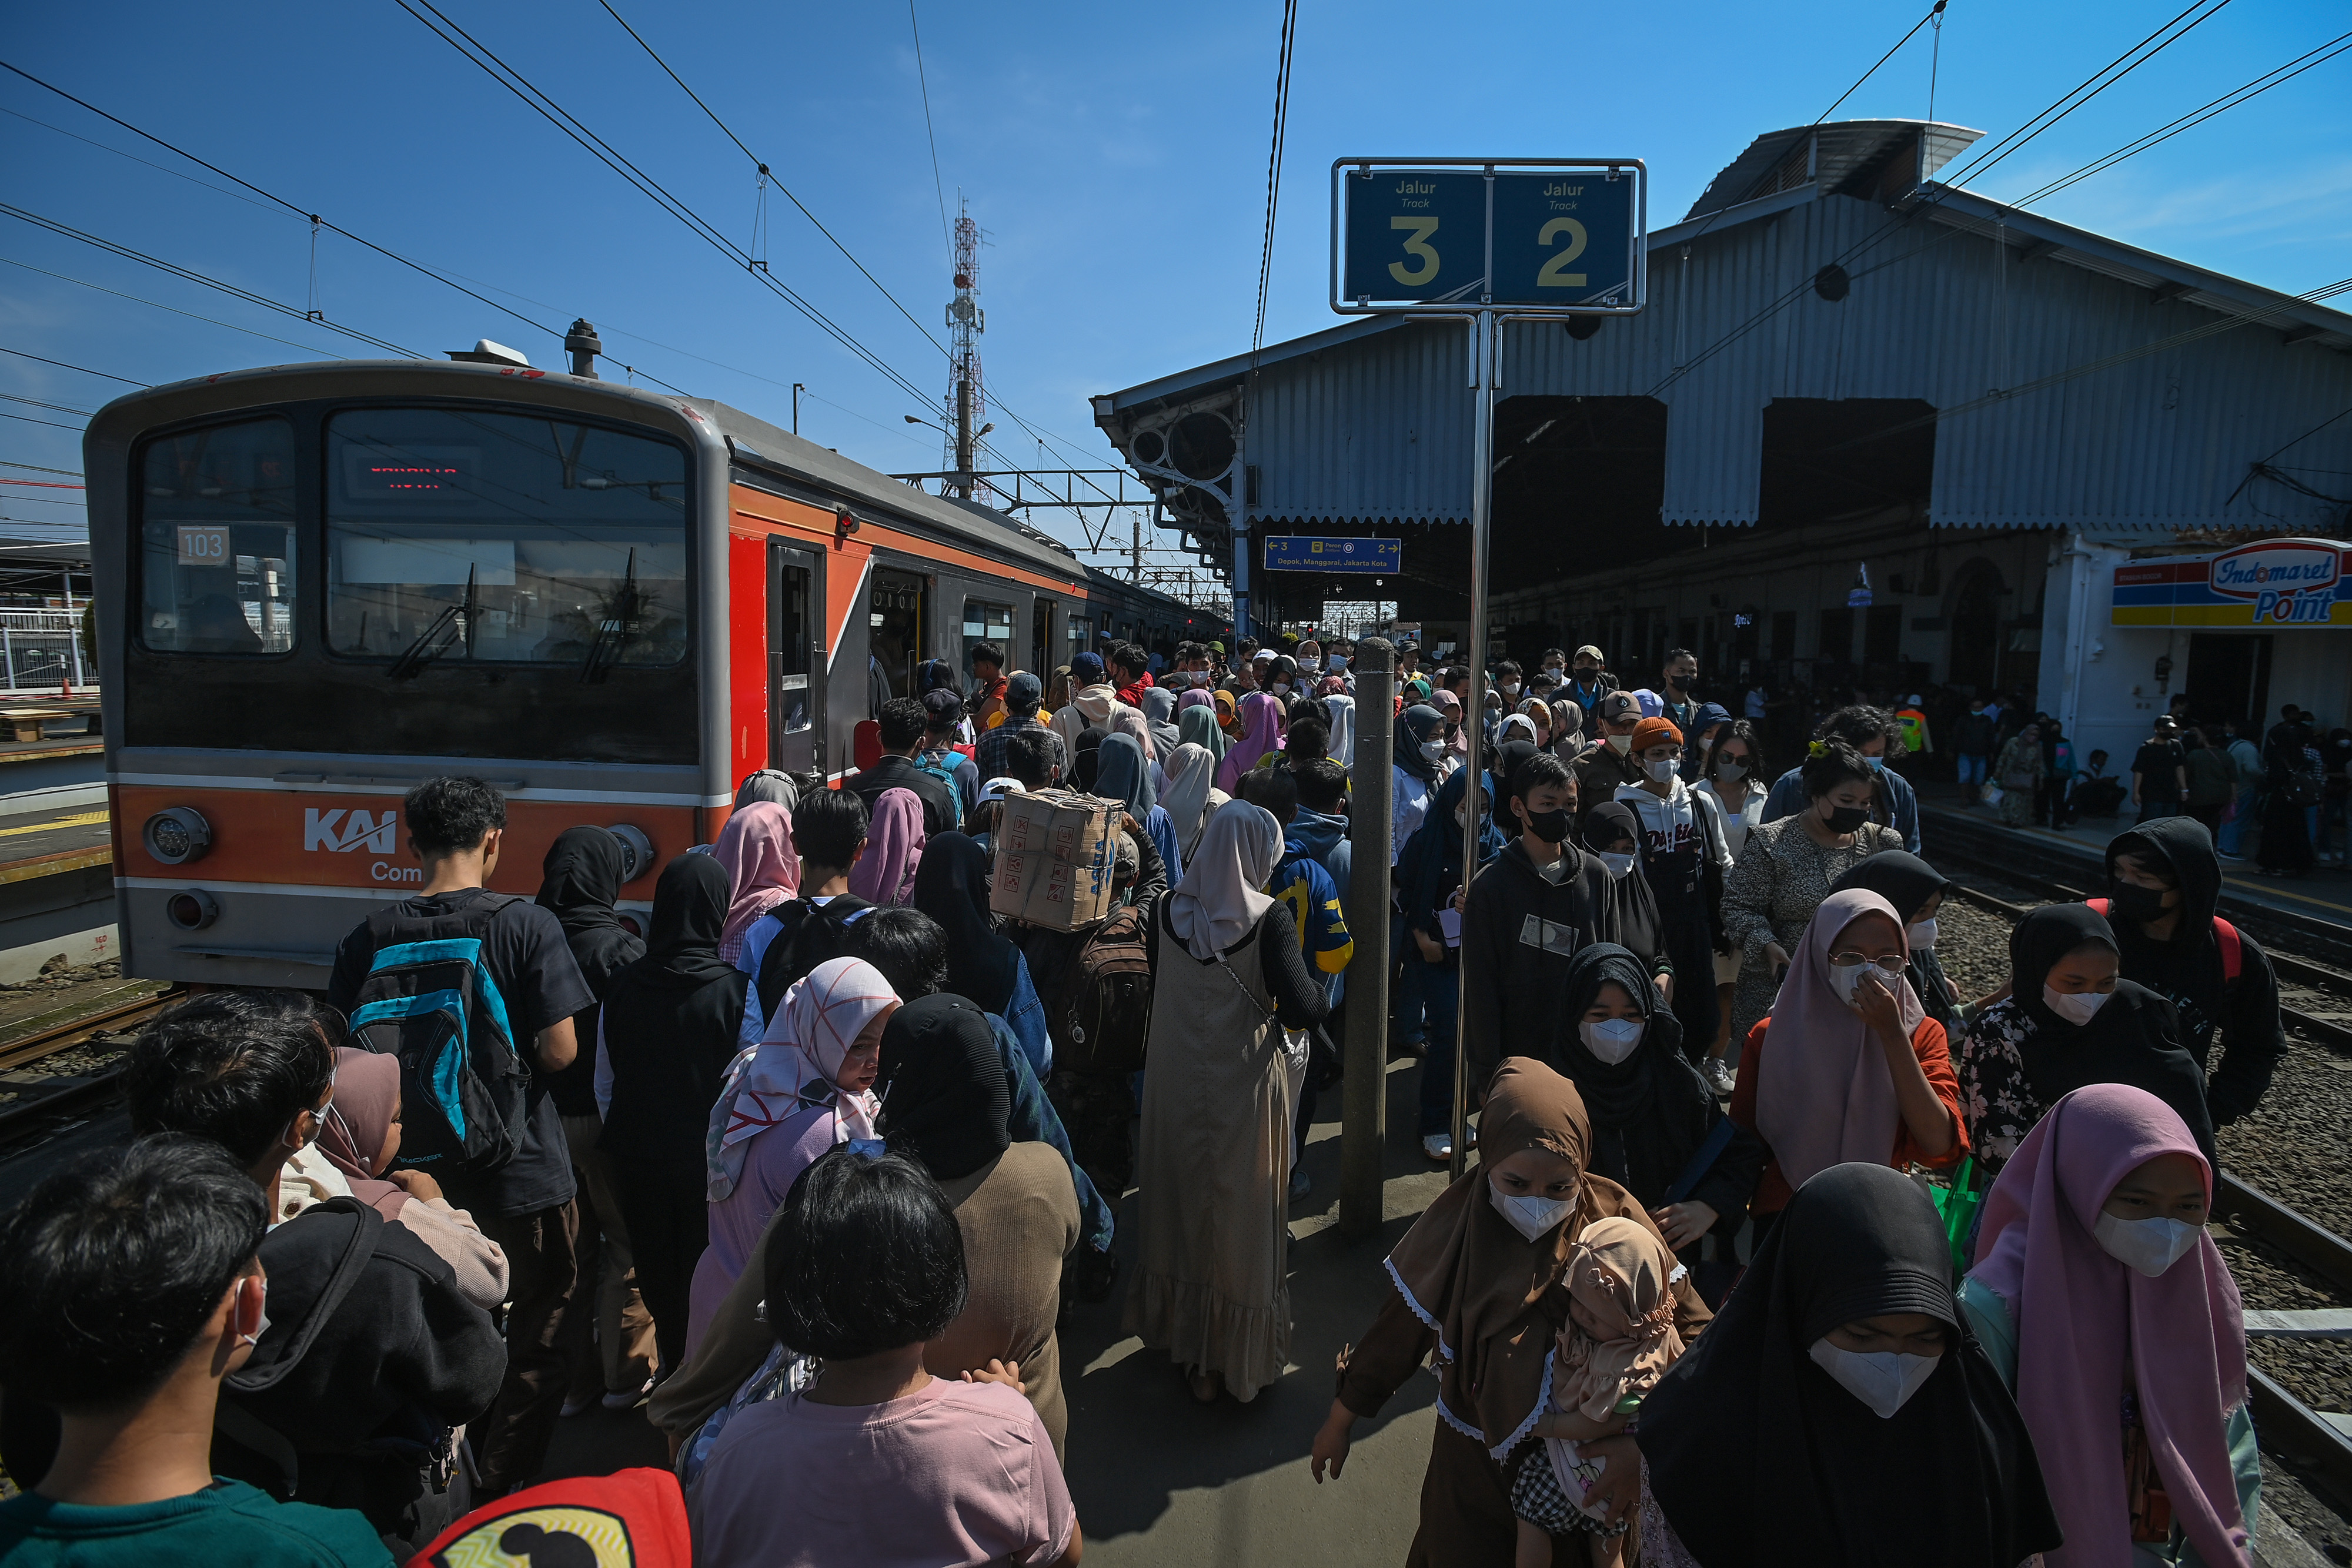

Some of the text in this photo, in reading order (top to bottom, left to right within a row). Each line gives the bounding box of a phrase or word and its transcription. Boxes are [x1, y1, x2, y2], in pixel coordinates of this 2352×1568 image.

[1396, 180, 1436, 194] Jalur
[1544, 183, 1583, 197] Jalur
[1402, 198, 1429, 208] Track
[1549, 200, 1578, 210] Track
[1388, 216, 1440, 286] 3
[1536, 217, 1588, 287] 2
[185, 534, 222, 557] 103
[1281, 541, 1288, 551] 3
[1378, 544, 1385, 553] 2
[1304, 559, 1342, 567] Manggarai,
[2217, 556, 2331, 584] Indomaret
[2253, 589, 2334, 623] Point
[305, 808, 396, 854] KAI
[372, 861, 423, 881] Com
[396, 1153, 443, 1164] TRACKER
